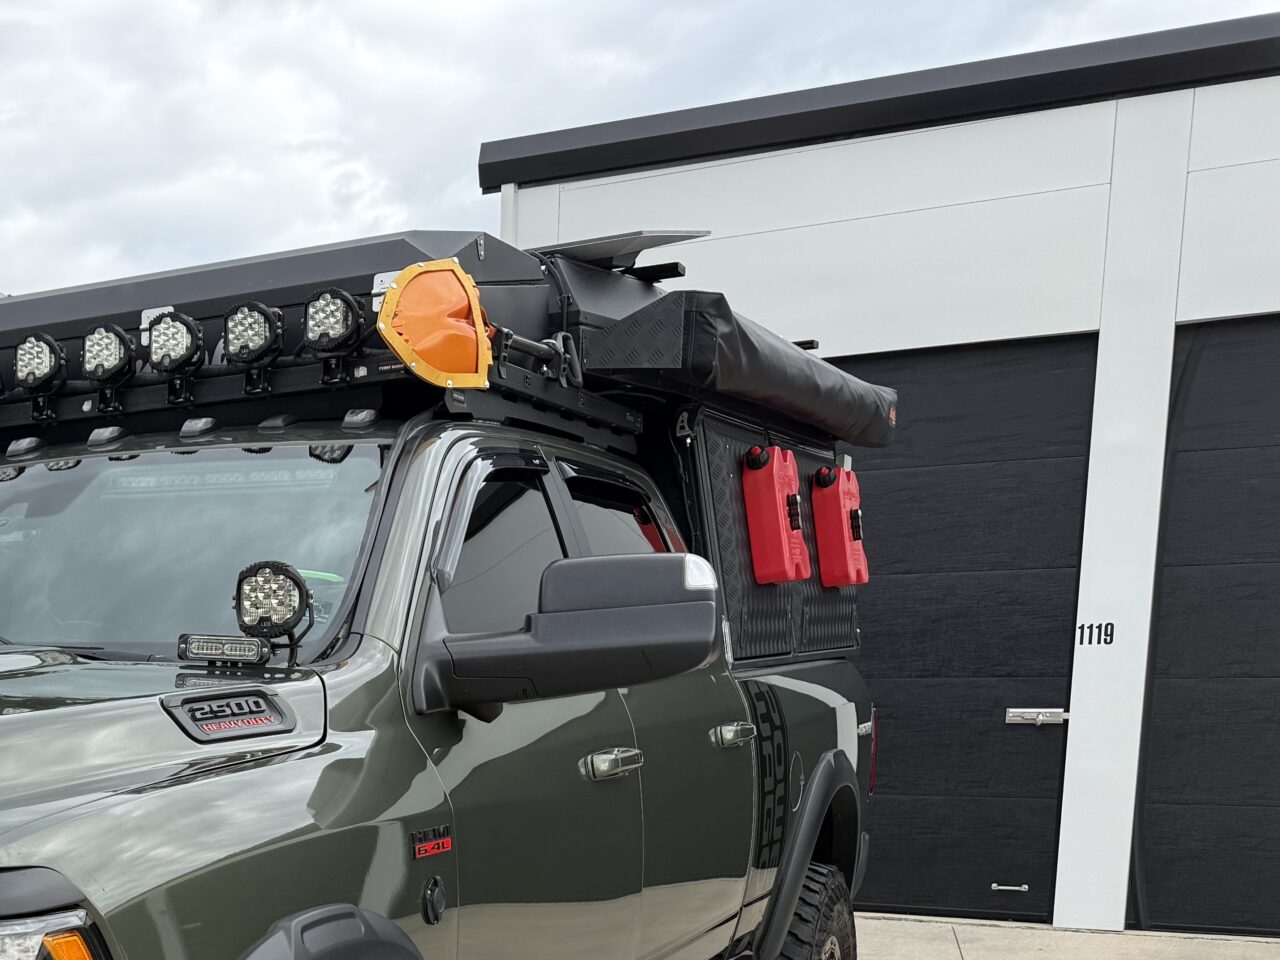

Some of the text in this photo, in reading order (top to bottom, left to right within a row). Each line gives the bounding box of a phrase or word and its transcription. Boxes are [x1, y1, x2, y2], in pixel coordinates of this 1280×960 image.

[1078, 622, 1115, 645] 1119
[187, 699, 267, 721] 2500
[202, 715, 276, 733] HEAVY DUTY
[417, 841, 449, 856] 6.4L
